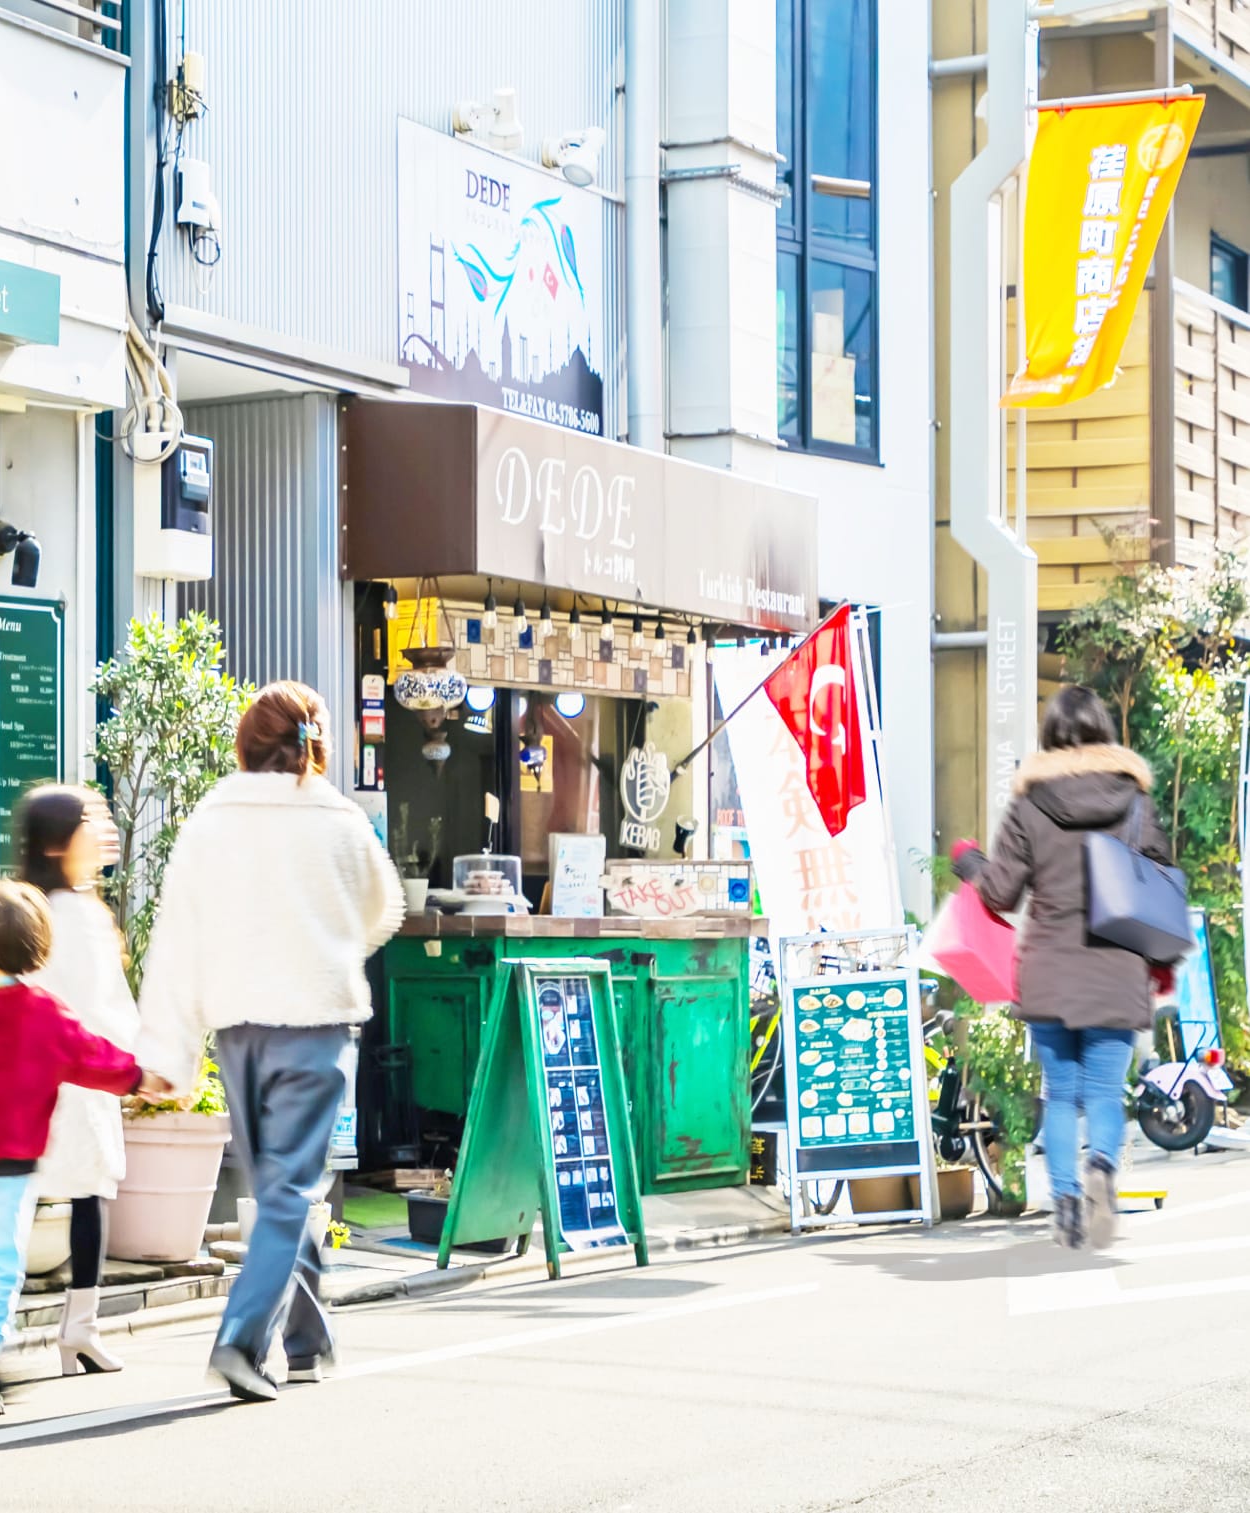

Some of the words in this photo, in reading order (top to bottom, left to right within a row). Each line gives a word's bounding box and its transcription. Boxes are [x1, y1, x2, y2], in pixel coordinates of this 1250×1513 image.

[465, 168, 511, 213] DEDE
[502, 386, 545, 420] TEL&FAX
[494, 446, 637, 550] DEDE
[696, 567, 743, 605] Turkish
[746, 578, 807, 617] Restaurant
[621, 821, 661, 851] KEBAB
[613, 879, 664, 910] TAKE
[654, 885, 697, 916] OUT
